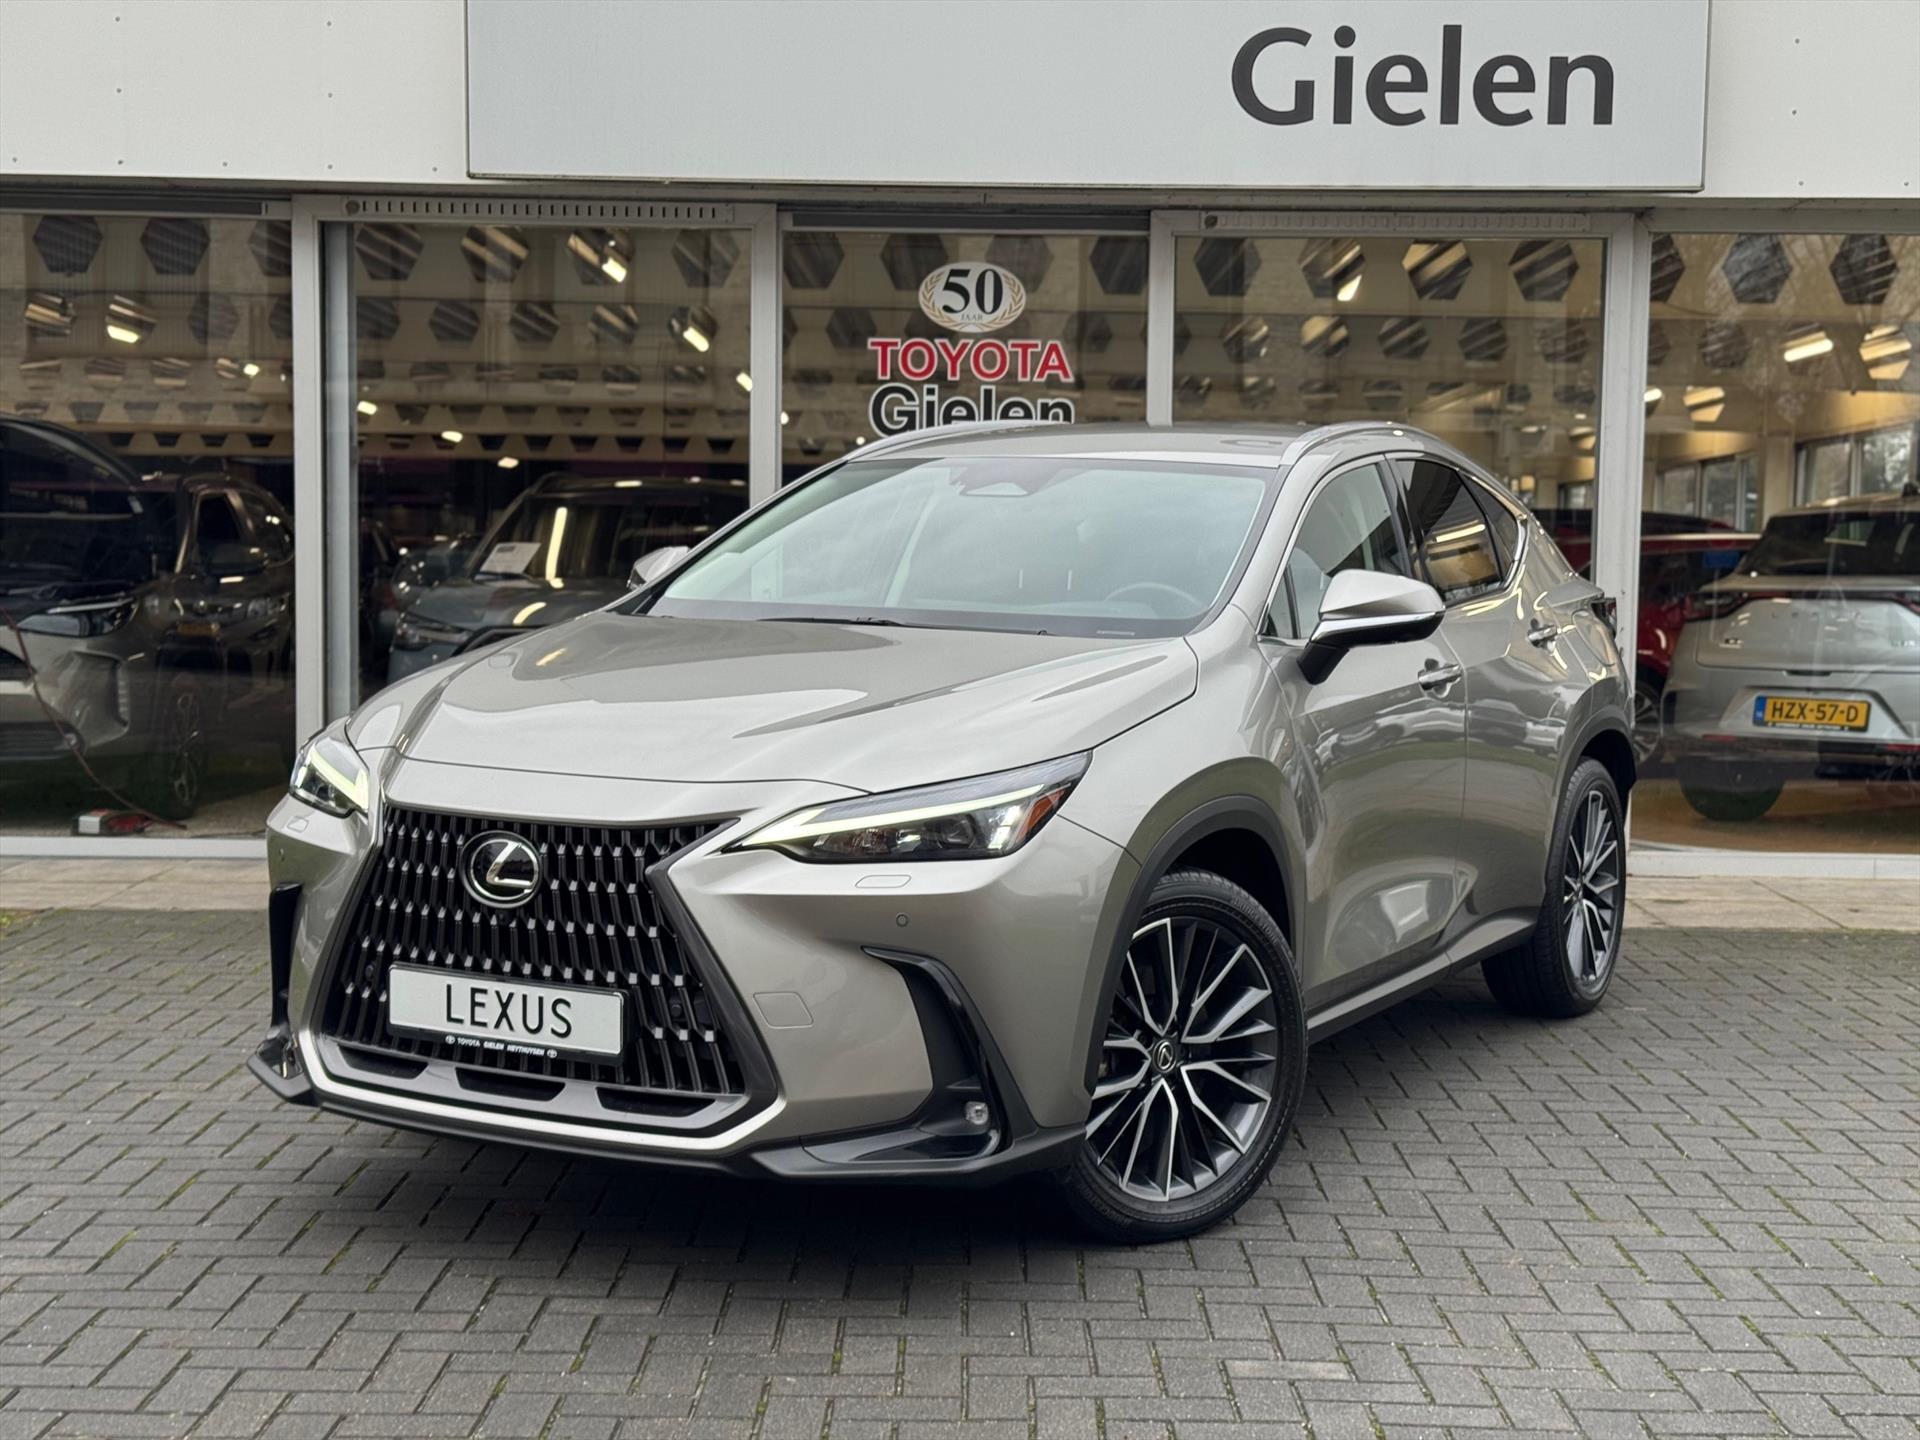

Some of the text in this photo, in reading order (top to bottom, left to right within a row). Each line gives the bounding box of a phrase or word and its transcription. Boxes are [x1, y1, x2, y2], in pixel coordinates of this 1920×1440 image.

[1231, 24, 1614, 126] Gielen
[942, 268, 1003, 314] 50
[961, 313, 983, 321] JAAR
[868, 338, 1074, 382] TOYOTA
[869, 382, 1075, 438] Gielen
[1771, 701, 1859, 723] HZX-57-D
[446, 983, 572, 1038] LEXUS
[457, 1037, 480, 1047] TOYOTA
[483, 1040, 505, 1050] GIELEN
